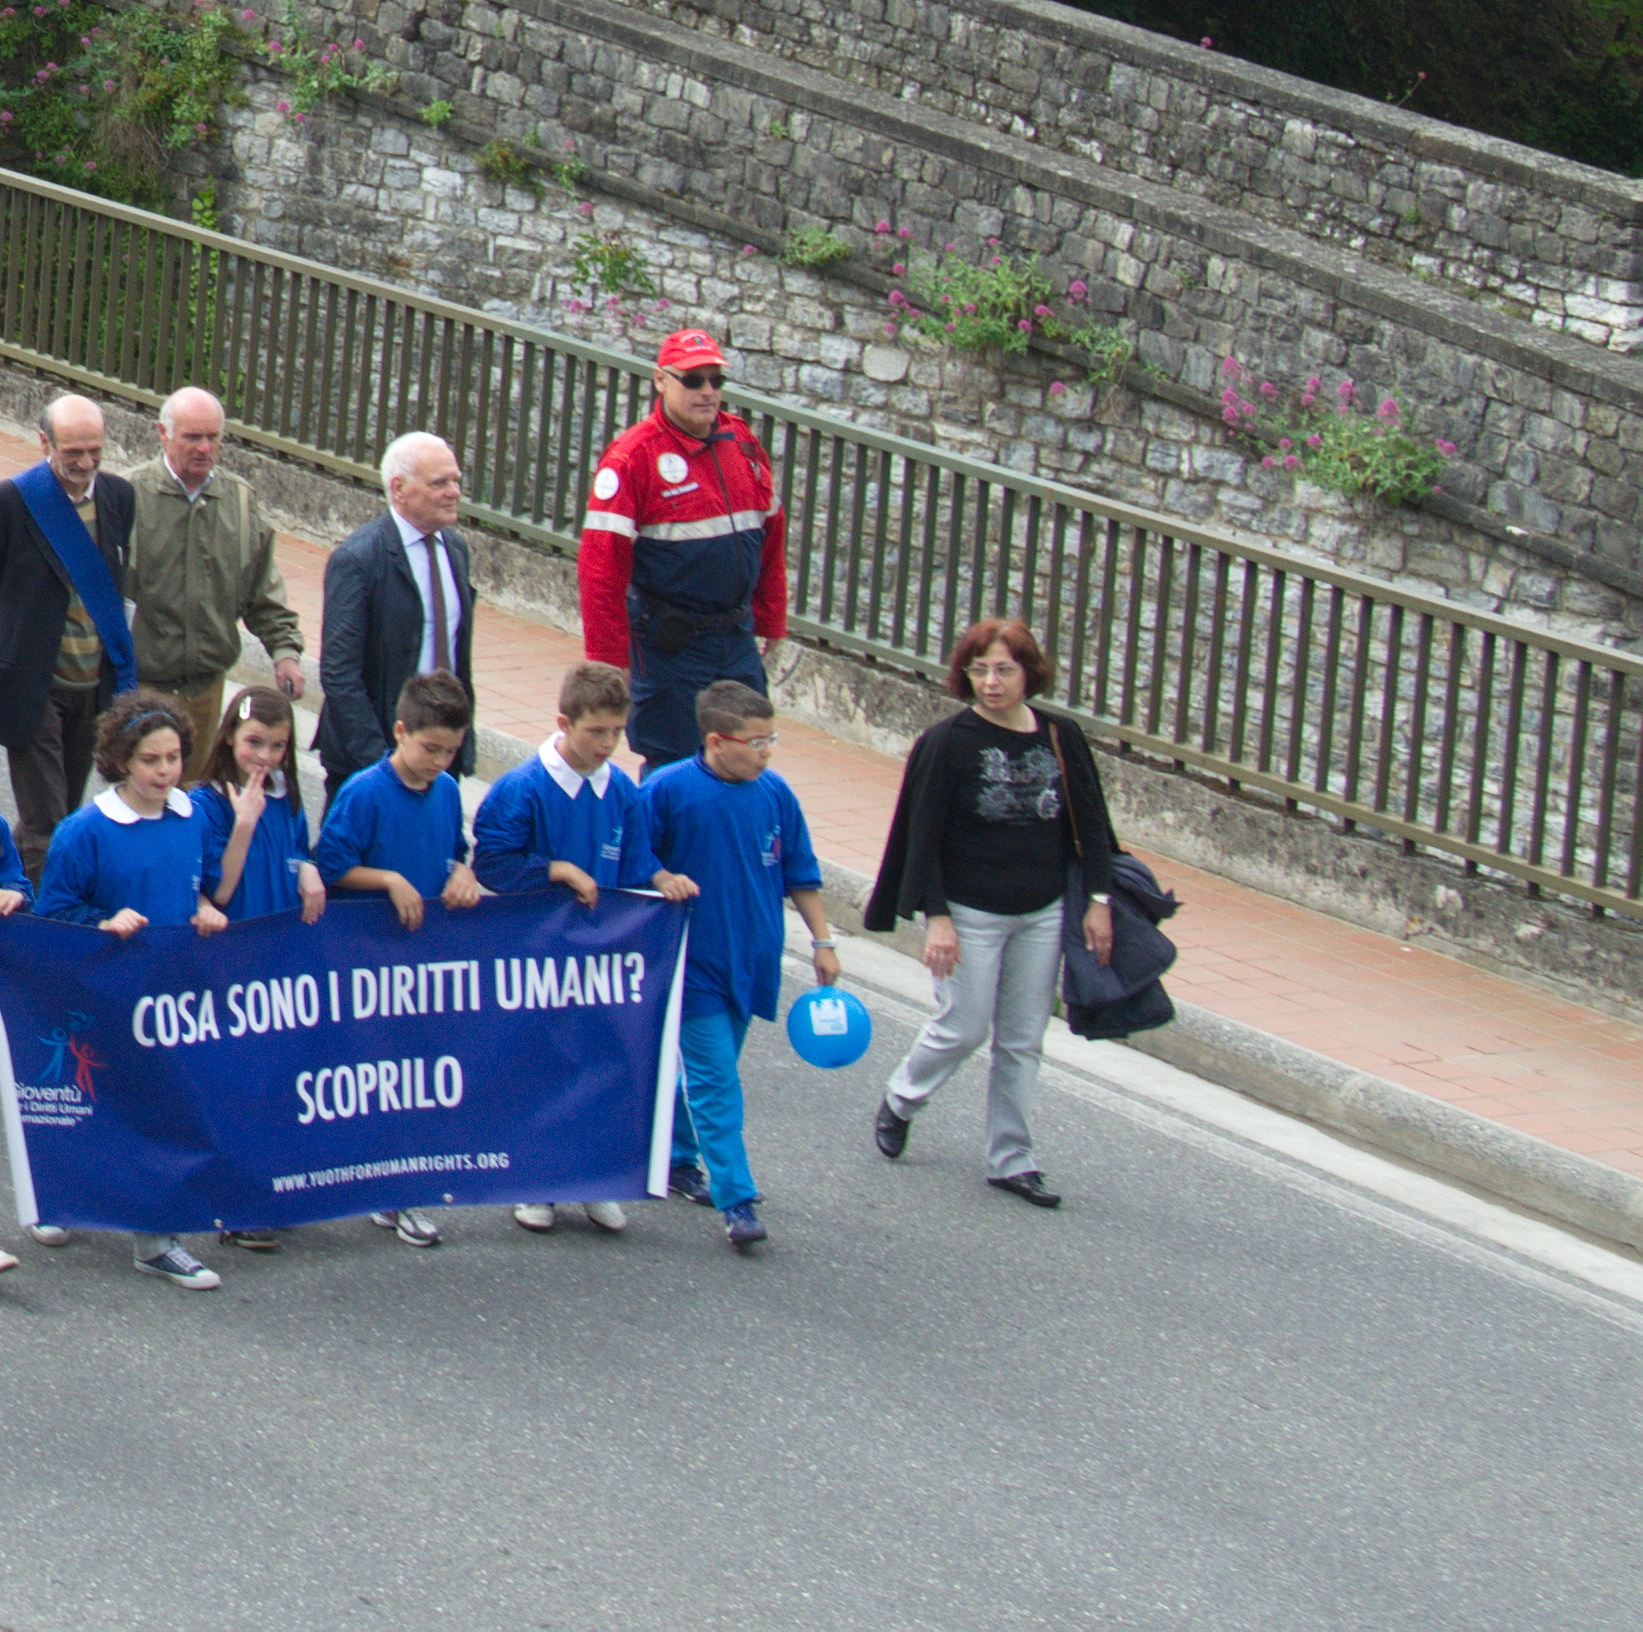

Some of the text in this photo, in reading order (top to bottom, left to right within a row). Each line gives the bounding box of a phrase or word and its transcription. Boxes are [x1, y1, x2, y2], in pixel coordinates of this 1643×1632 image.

[132, 951, 645, 1048] COSA SONO I DIRITTI UMANI?
[295, 1055, 464, 1125] SCOPRILO
